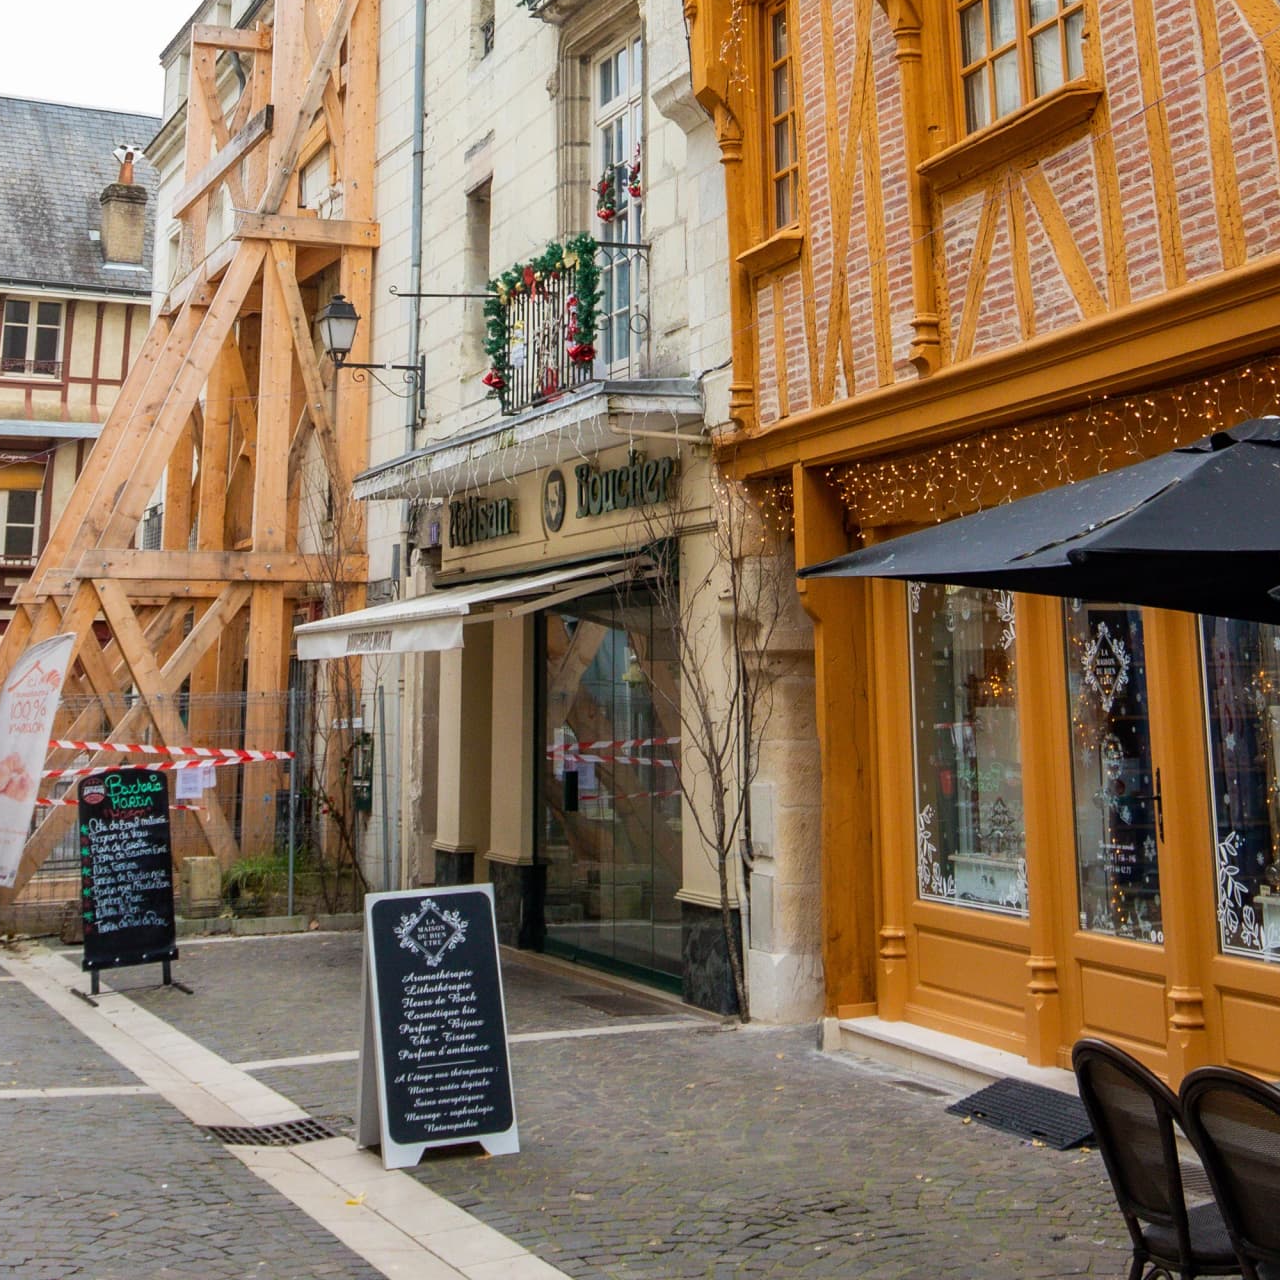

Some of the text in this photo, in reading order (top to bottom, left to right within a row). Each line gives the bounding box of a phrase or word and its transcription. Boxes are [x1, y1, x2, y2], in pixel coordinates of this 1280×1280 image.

[449, 449, 678, 549] Artisan Boucher
[418, 925, 445, 933] MAISON
[402, 969, 473, 983] Aromathérapie
[404, 981, 471, 995] Lithothérapie
[402, 992, 477, 1008] Fleurs de Bach
[404, 1005, 477, 1020] Cosmétique bio
[399, 1022, 437, 1035] Parfum
[448, 1018, 484, 1030] Bijoux
[409, 1035, 431, 1046] Thé
[442, 1032, 477, 1042] Tisane
[398, 1043, 490, 1061] Parfum d'ambiance
